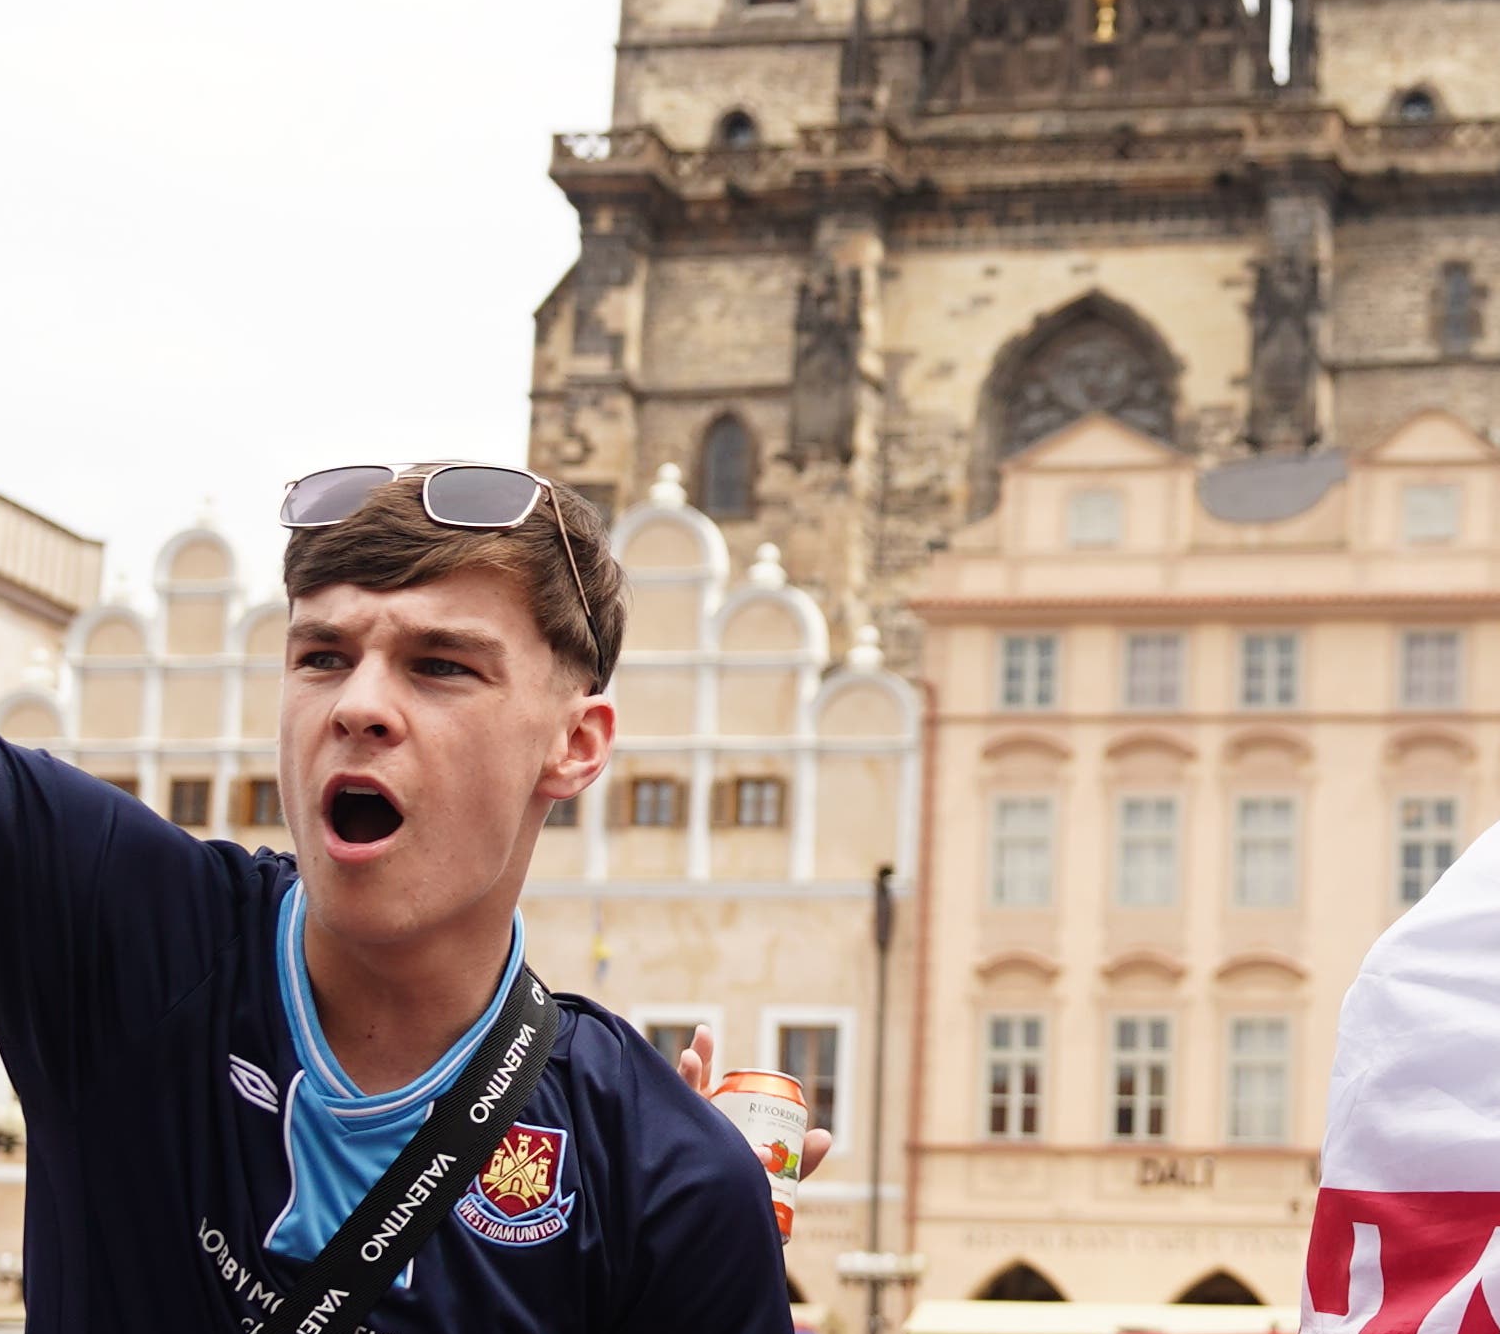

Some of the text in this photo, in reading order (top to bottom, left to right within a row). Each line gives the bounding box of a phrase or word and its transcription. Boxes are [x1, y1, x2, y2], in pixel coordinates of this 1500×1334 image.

[469, 1023, 537, 1124] VALENTINO
[361, 1153, 457, 1263] VALENTINO
[459, 1199, 561, 1242] WEST HAM UNITED
